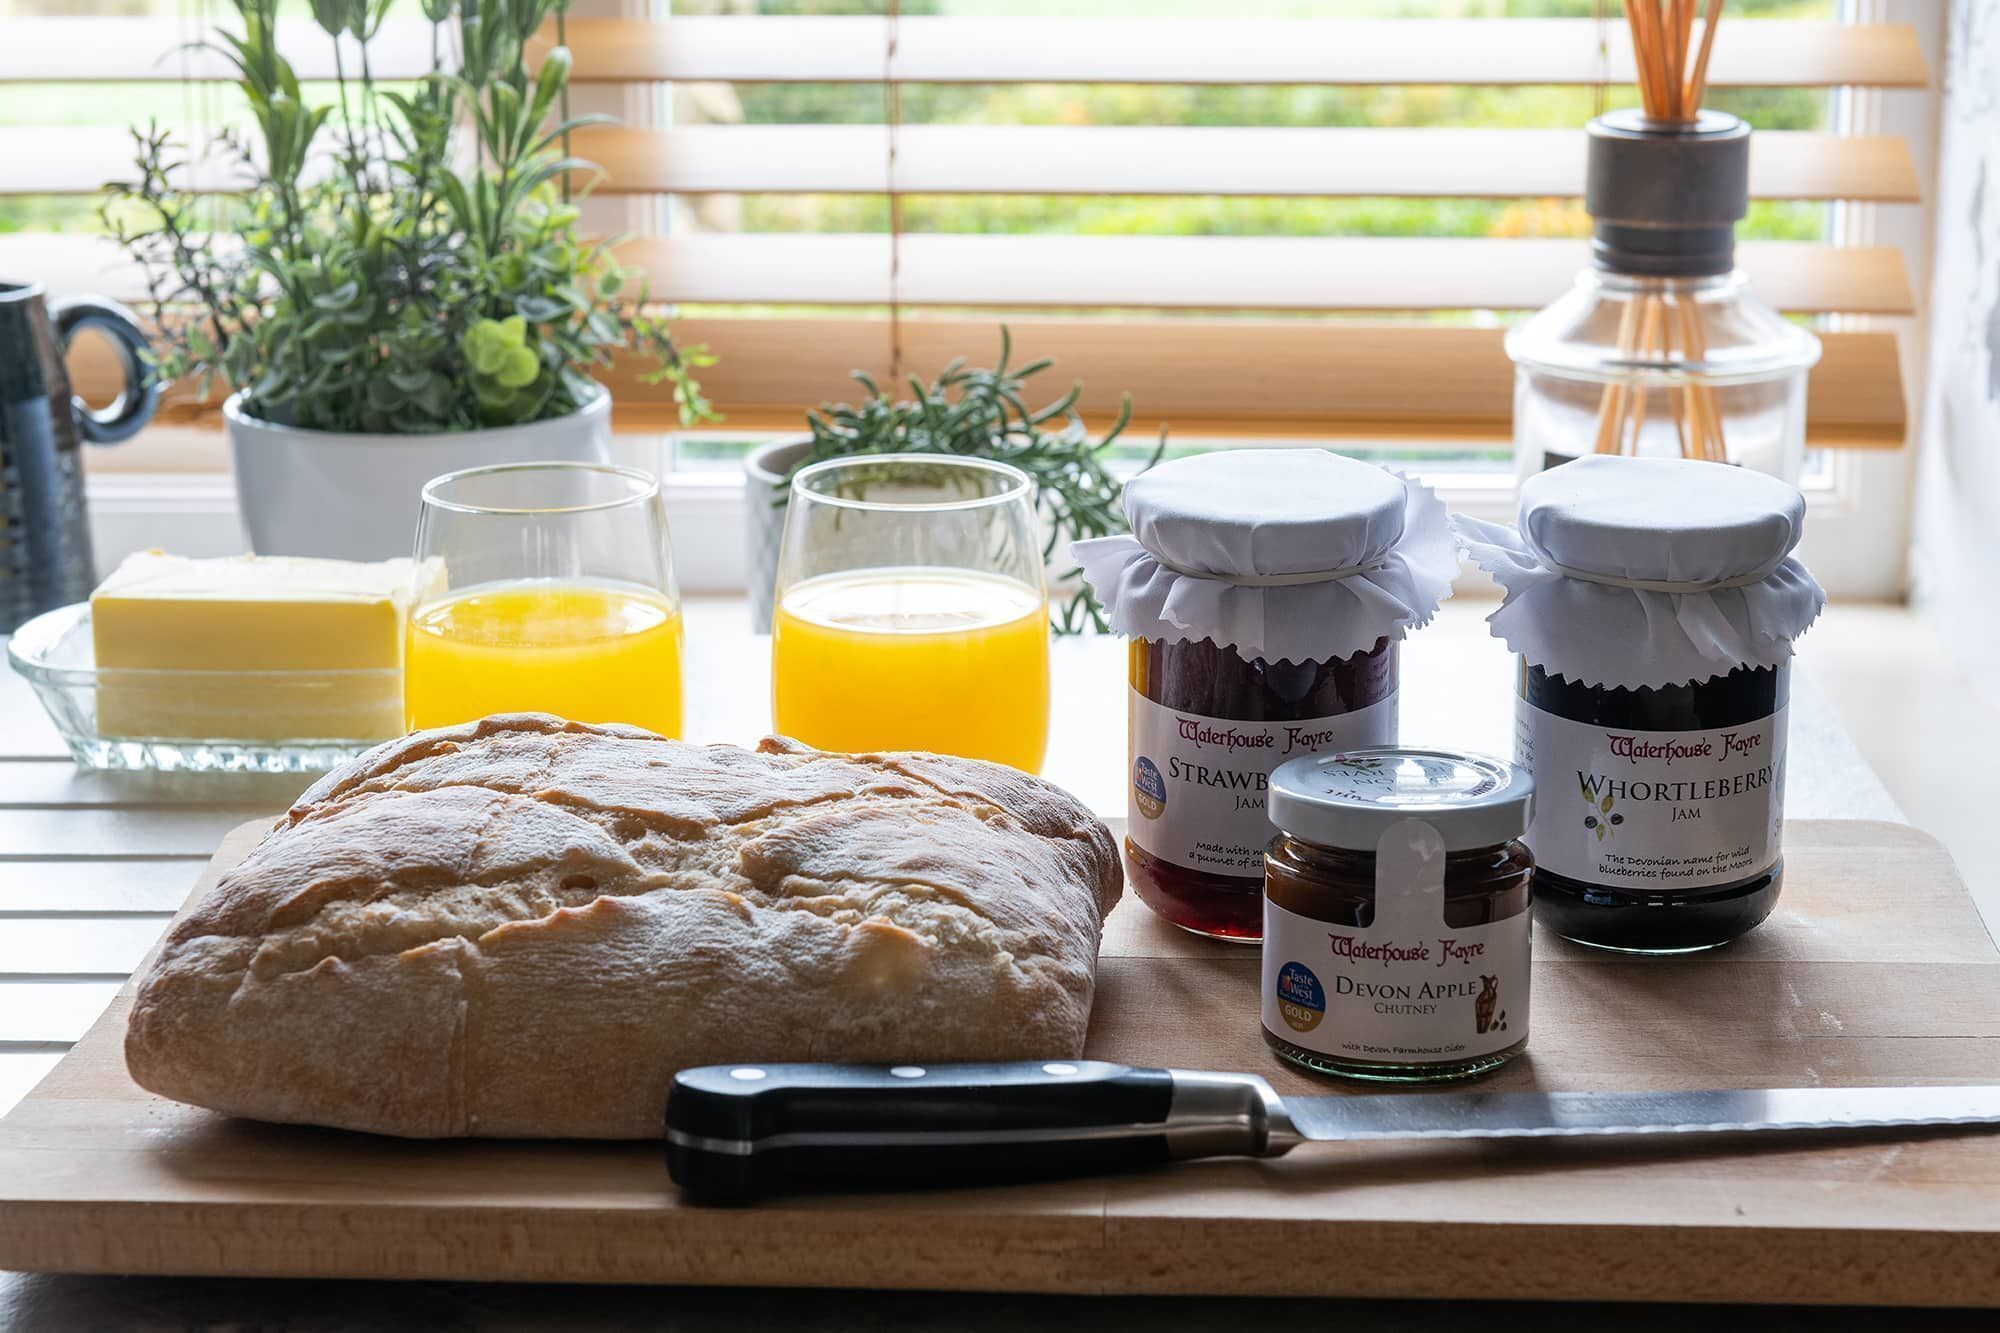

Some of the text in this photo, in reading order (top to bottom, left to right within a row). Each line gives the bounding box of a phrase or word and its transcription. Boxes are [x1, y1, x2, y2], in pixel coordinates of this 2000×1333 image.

[1176, 716, 1334, 754] Waterhouse Fayre
[1606, 732, 1761, 766] Waterhouse Fayre
[1168, 756, 1269, 791] STRAWB
[1576, 762, 1776, 801] WHORTLEBERRY
[1234, 795, 1265, 811] JAM
[1671, 807, 1701, 823] JAM
[1195, 842, 1223, 853] Made
[1225, 844, 1250, 856] with
[1605, 845, 1750, 867] The Devonian name for wild
[1188, 851, 1195, 859] a
[1197, 853, 1235, 866] punnet
[1237, 857, 1250, 869] of
[1599, 858, 1754, 880] blueberries found on the Moors
[1328, 932, 1485, 967] Waterhouse Fayre
[1289, 967, 1314, 986] Taste
[1290, 982, 1313, 1001] West
[1336, 975, 1409, 1000] DEVON
[1417, 981, 1476, 1000] APPLE
[1284, 1004, 1313, 1022] GOLD
[1374, 1002, 1438, 1015] CHUTNEY
